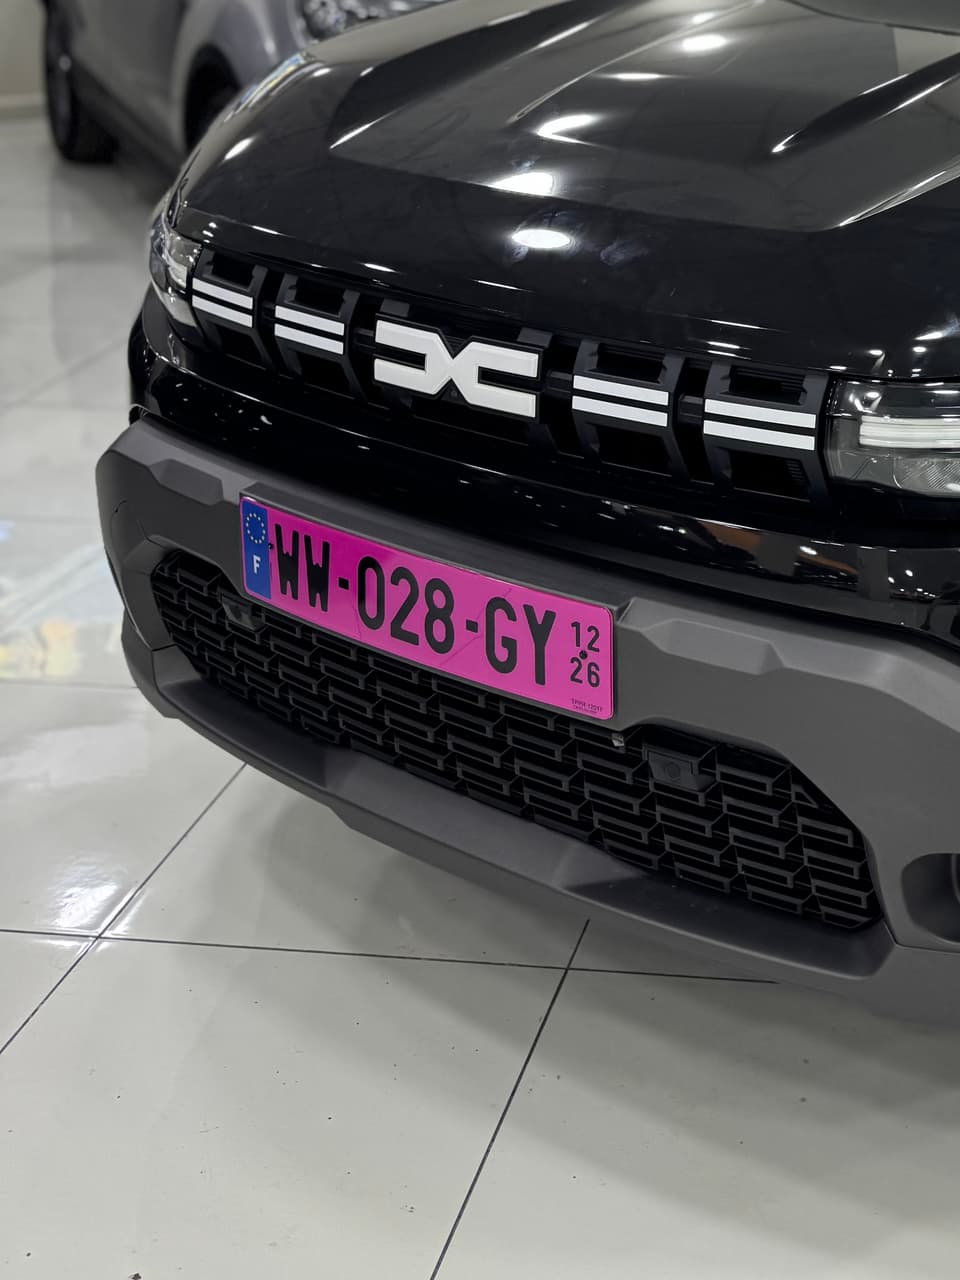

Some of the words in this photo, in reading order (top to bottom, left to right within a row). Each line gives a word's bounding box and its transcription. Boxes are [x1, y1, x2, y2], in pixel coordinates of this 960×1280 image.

[253, 554, 262, 575] F
[274, 523, 556, 686] WW-028-GY
[570, 621, 600, 653] 12
[570, 656, 600, 688] 26
